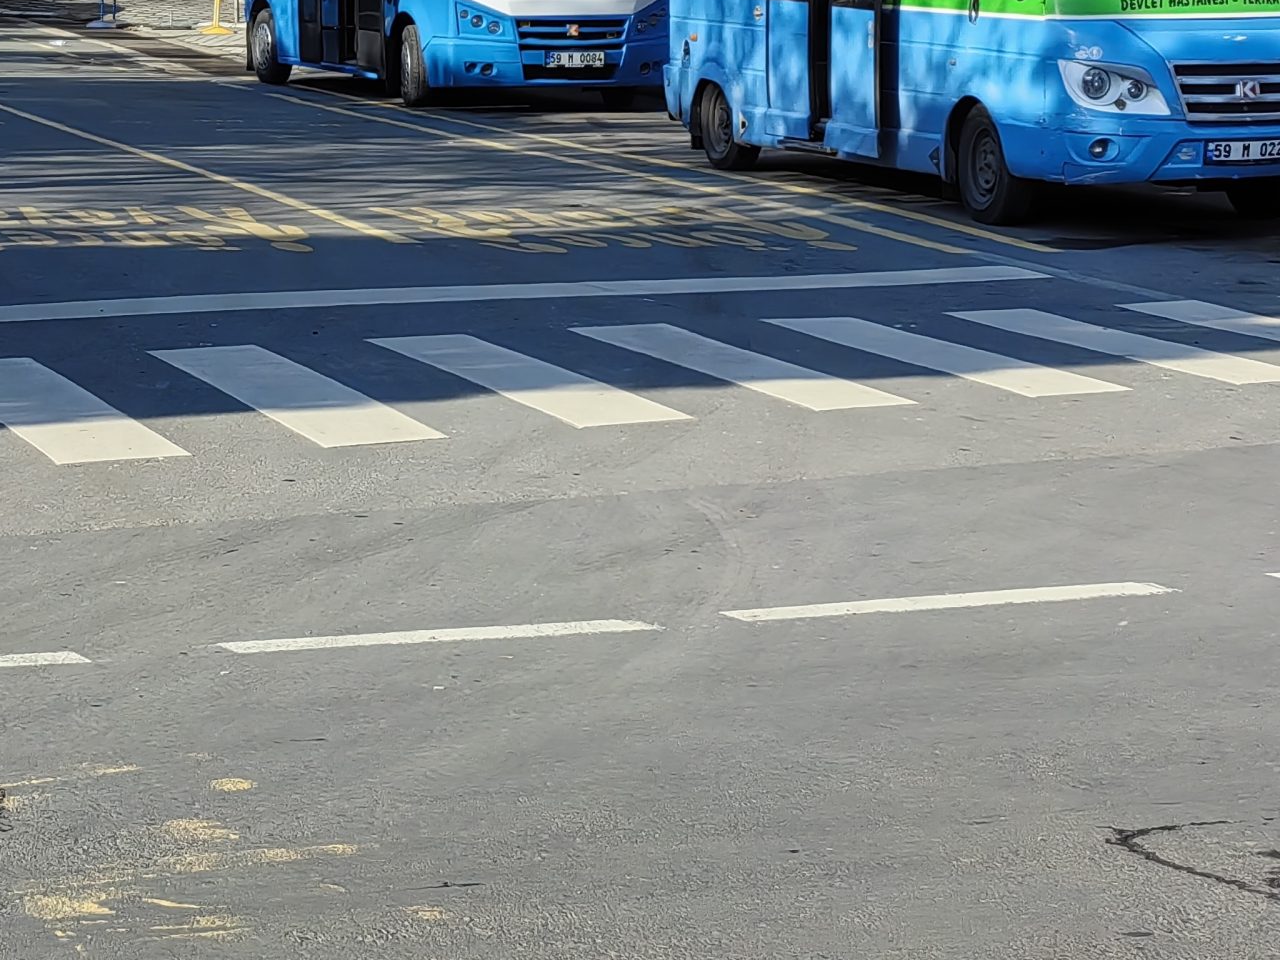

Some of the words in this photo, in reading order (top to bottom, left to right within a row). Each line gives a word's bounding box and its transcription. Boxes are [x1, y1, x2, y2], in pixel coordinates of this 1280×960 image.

[551, 53, 562, 63] 59
[1214, 143, 1231, 158] 59
[1242, 143, 1251, 157] M
